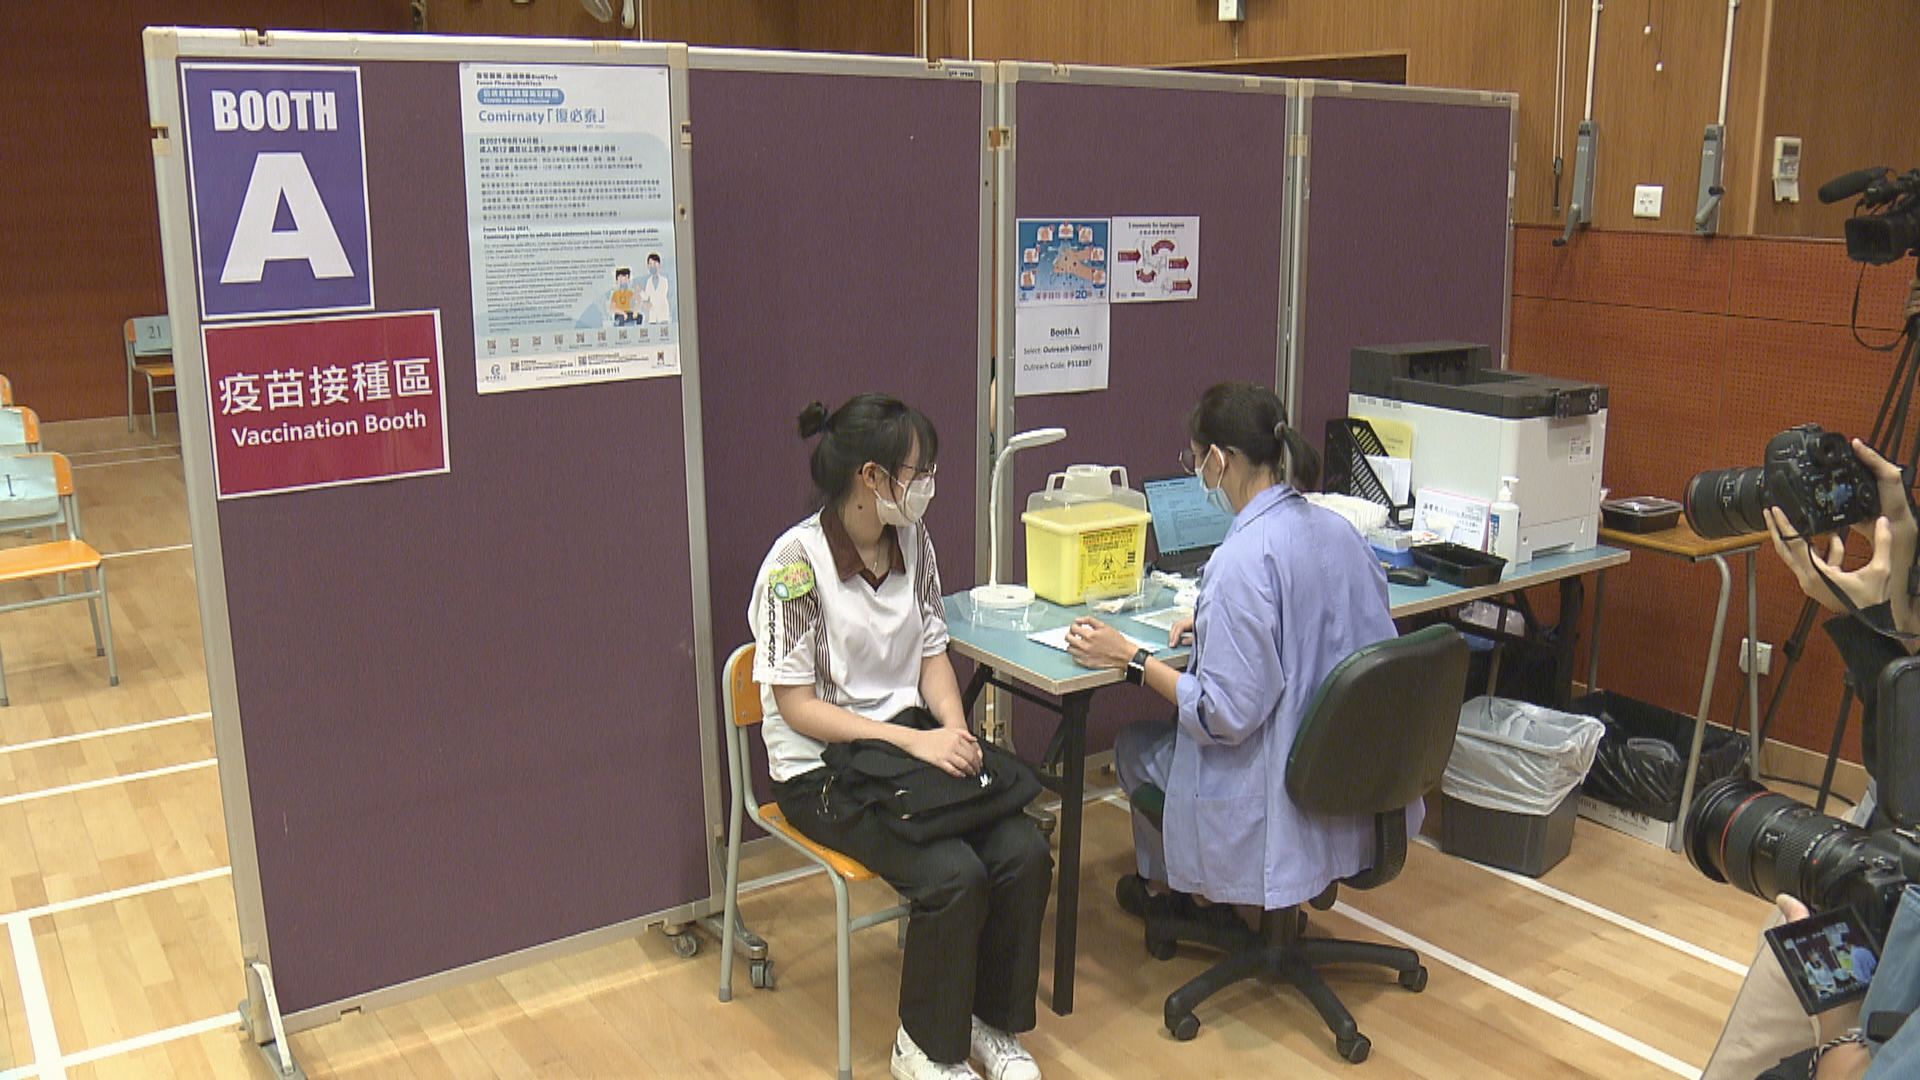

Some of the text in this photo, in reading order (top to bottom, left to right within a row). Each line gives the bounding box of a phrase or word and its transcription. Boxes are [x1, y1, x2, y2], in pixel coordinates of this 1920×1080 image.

[211, 89, 338, 132] BOOTH
[479, 109, 545, 125] Comirnaty
[220, 151, 355, 284] A
[1075, 290, 1088, 299] 20
[148, 325, 161, 339] 21
[1050, 326, 1080, 337] Booth A
[1043, 345, 1069, 353] Outreach
[1023, 362, 1049, 371] Outreach
[218, 356, 433, 416] 疫苗接種區
[231, 408, 427, 448] Vaccination Booth
